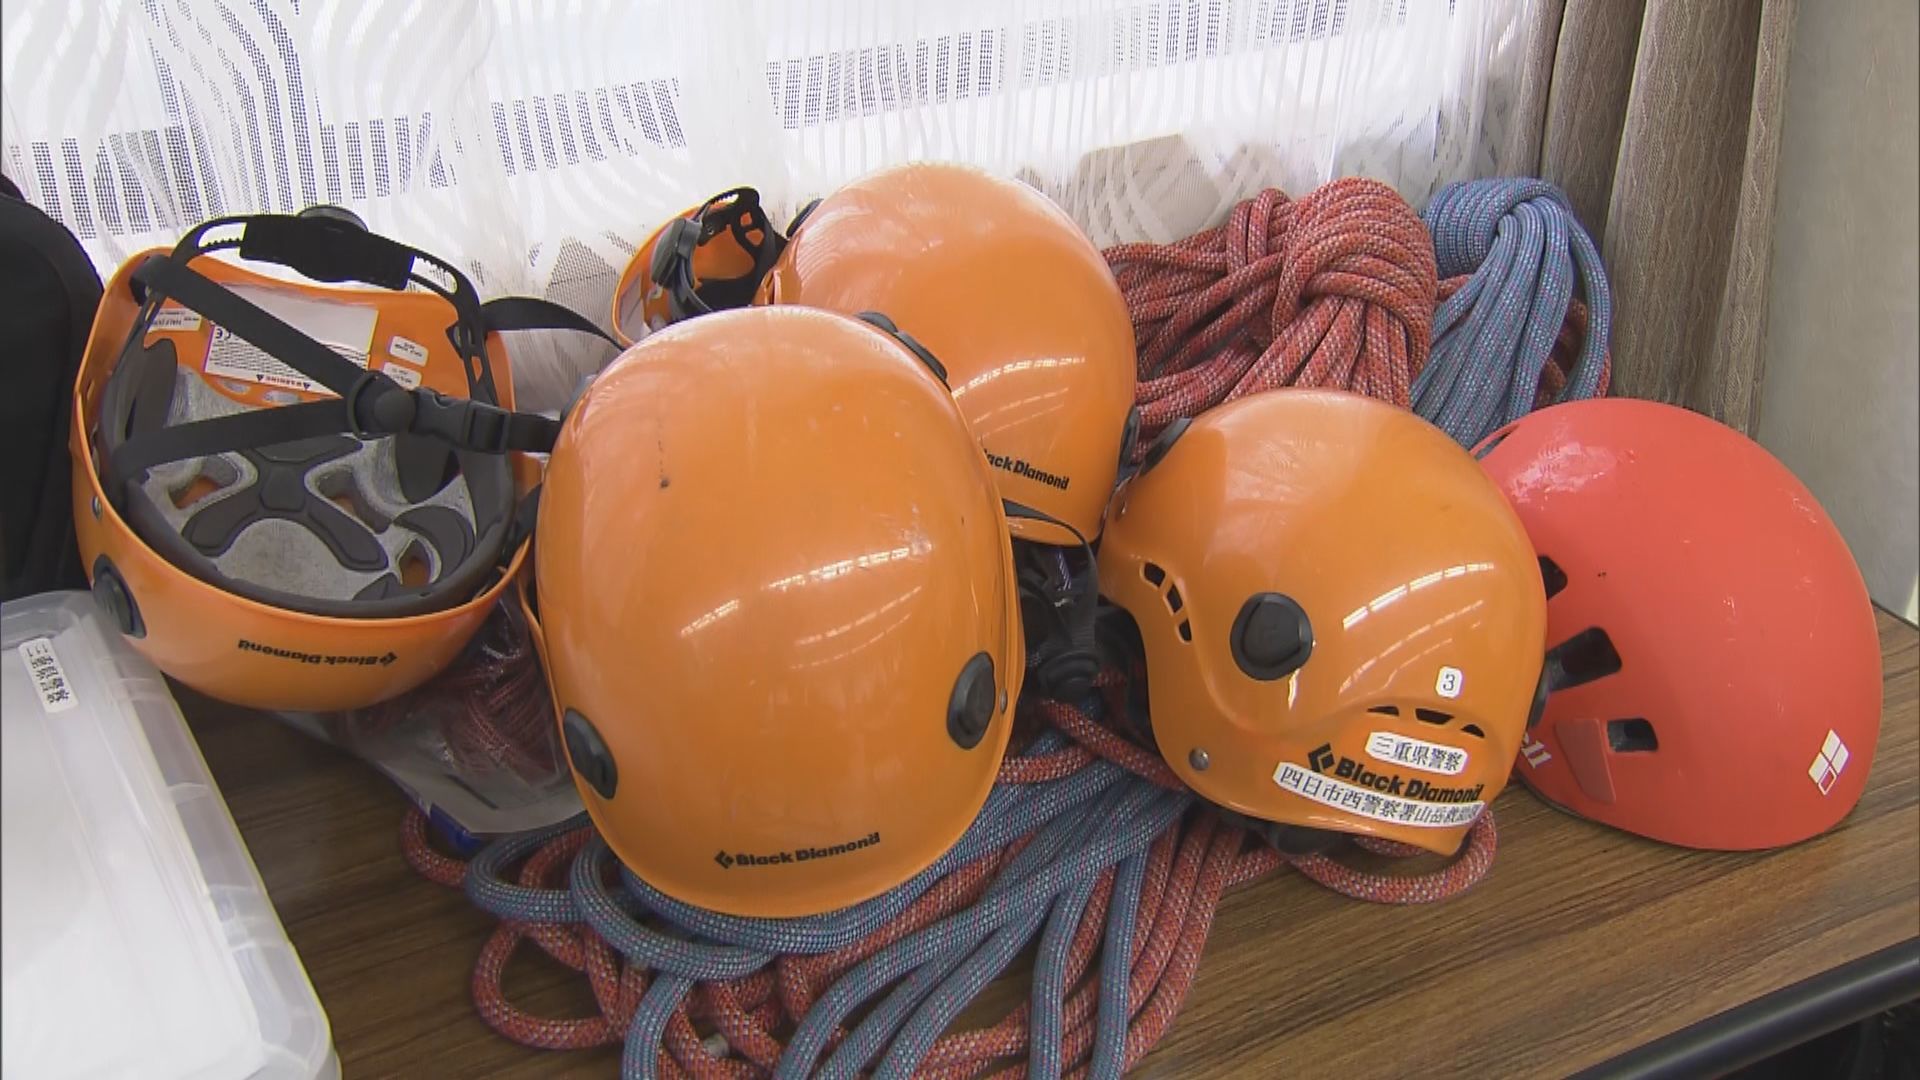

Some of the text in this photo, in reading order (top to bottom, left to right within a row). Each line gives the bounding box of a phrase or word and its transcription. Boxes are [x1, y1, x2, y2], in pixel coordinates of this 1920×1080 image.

[984, 448, 1070, 490] ack Diamond
[237, 639, 378, 665] Black Diamond
[1442, 673, 1456, 691] 3
[1371, 735, 1463, 771] 三重県警察
[1334, 756, 1485, 802] Black Diamond
[735, 832, 881, 866] Black Diamond
